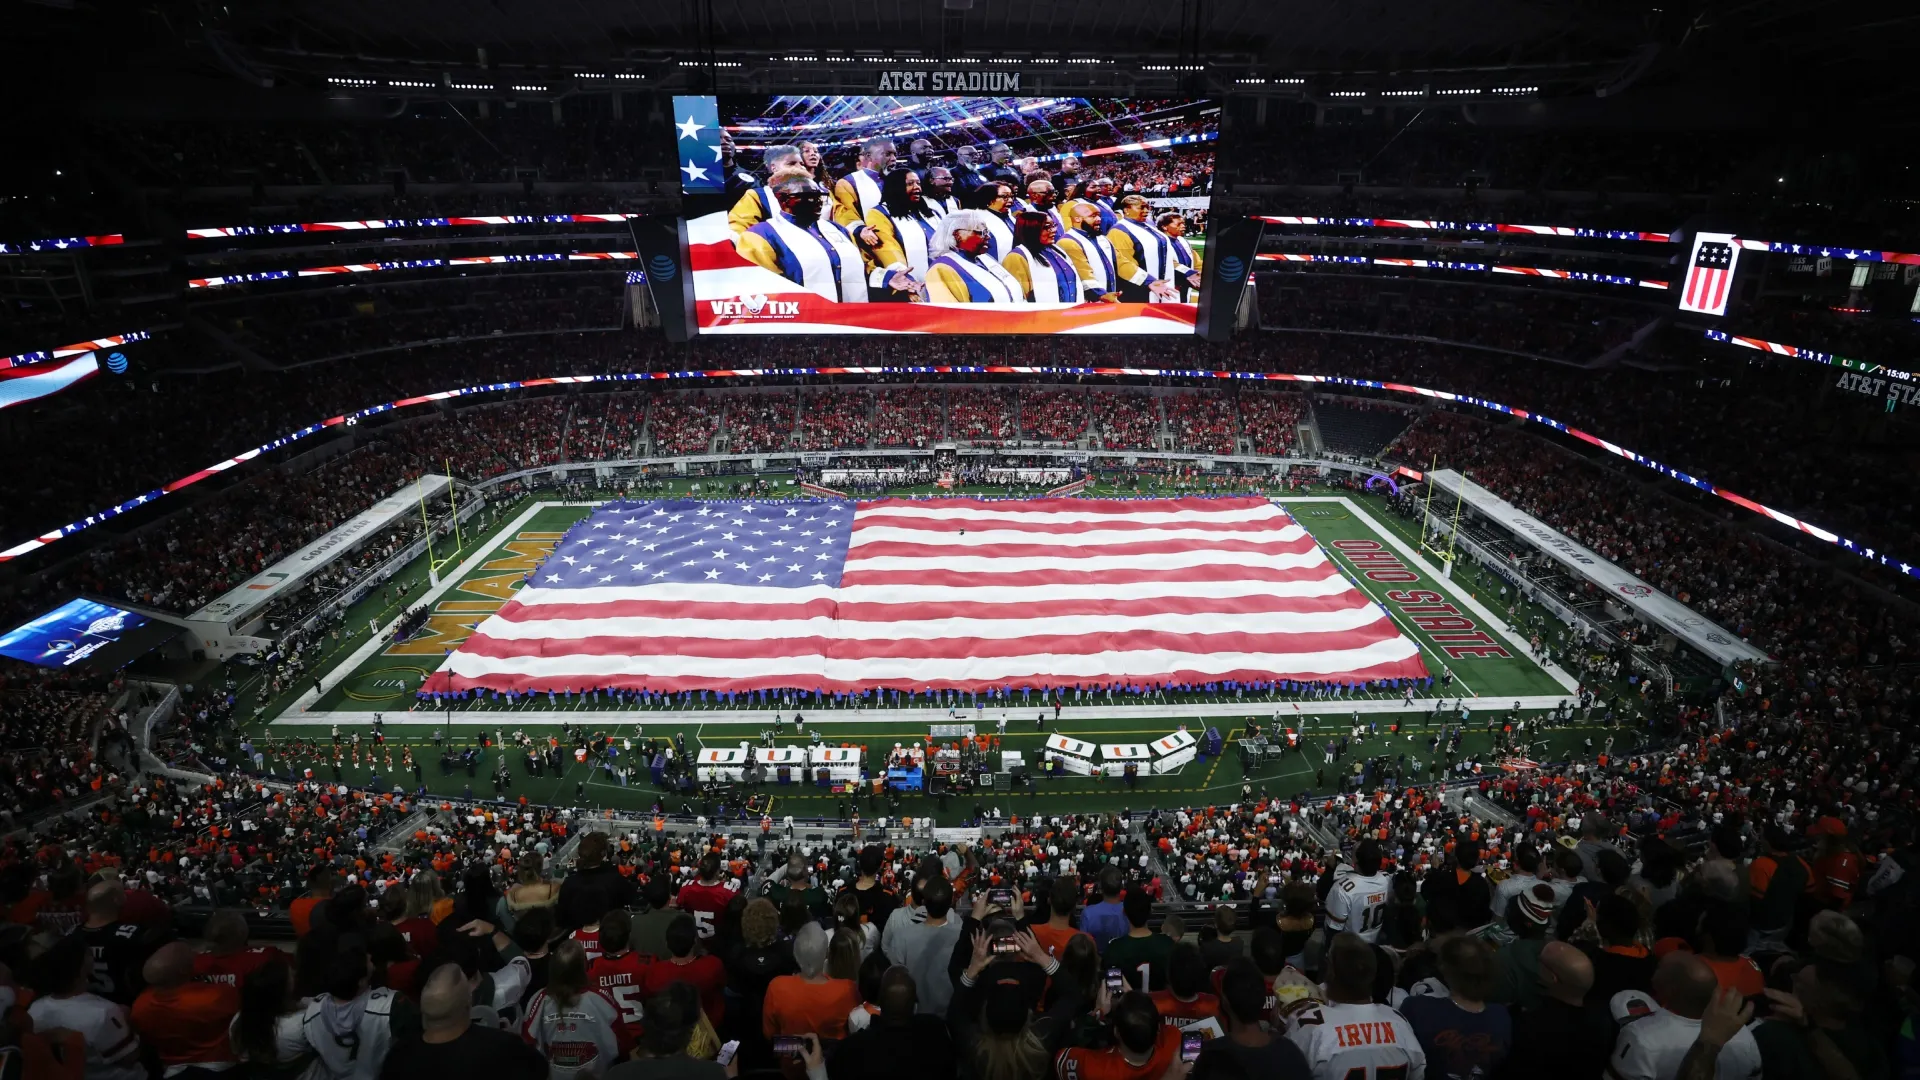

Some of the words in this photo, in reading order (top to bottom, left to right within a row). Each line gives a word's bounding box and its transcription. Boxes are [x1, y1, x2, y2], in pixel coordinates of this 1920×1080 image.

[879, 72, 927, 91] AT&T
[932, 72, 1020, 91] STADIUM
[767, 300, 799, 315] TIX
[1836, 371, 1886, 397] AT&T
[1887, 369, 1910, 380] 15:00
[301, 519, 371, 561] GOODYEAR
[1512, 518, 1595, 566] GOODYEAR
[1488, 560, 1521, 587] GOODYEAR
[1331, 540, 1420, 582] OHIO
[1385, 590, 1514, 659] STATE
[1339, 878, 1356, 892] 10
[114, 924, 138, 939] 15
[693, 910, 716, 939] 5
[599, 973, 632, 987] ELLIOTT
[1136, 962, 1151, 993] 1
[612, 984, 644, 1024] 5
[335, 1031, 360, 1060] 9
[1335, 1021, 1396, 1047] IRVIN
